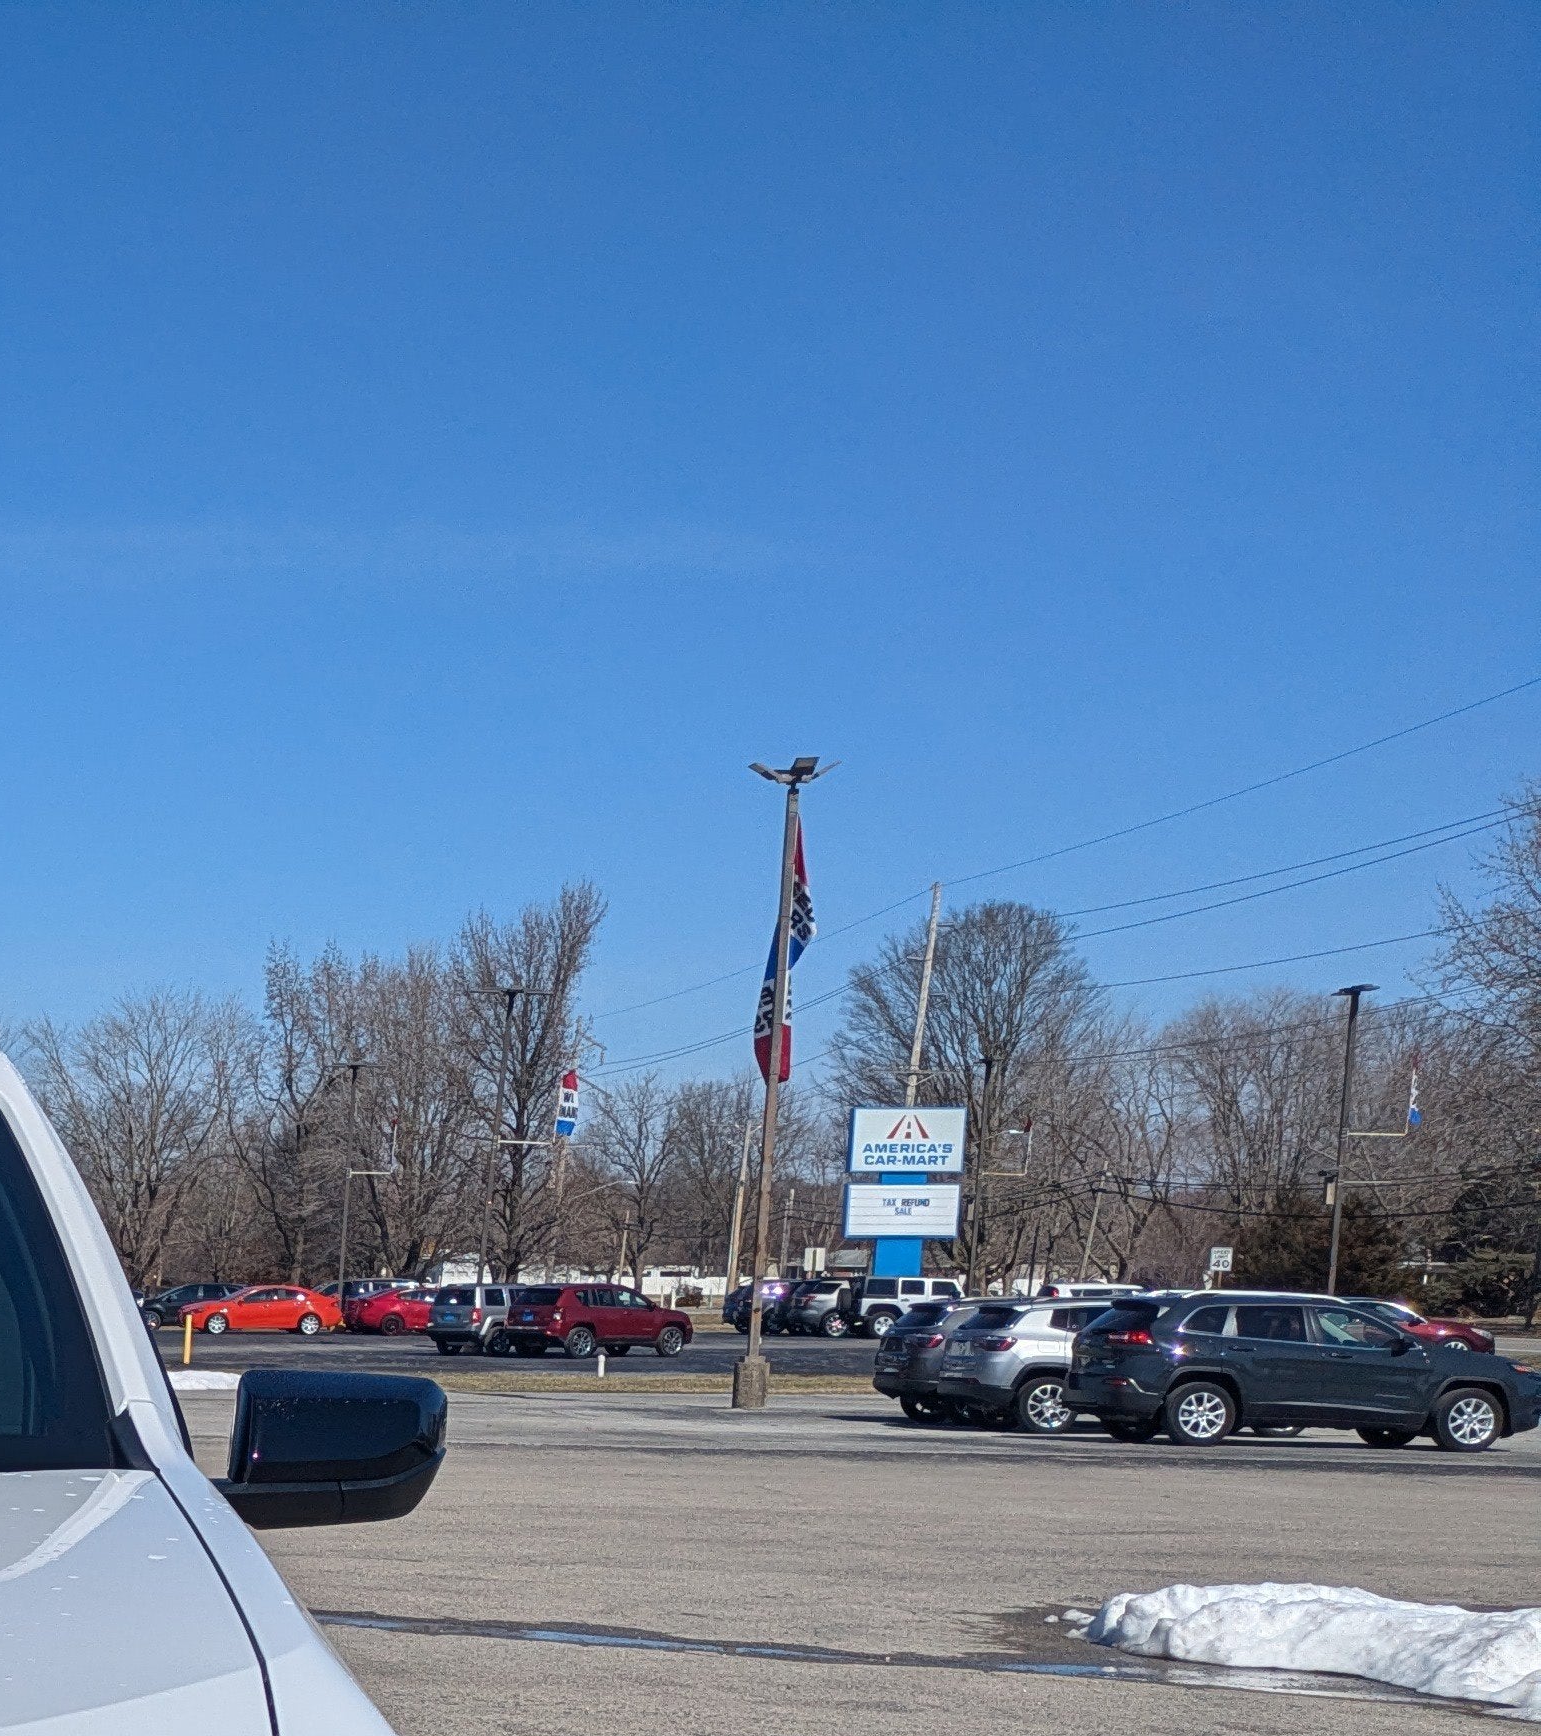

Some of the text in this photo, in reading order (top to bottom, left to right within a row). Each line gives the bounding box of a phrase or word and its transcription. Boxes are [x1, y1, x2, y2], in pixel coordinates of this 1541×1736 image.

[863, 1143, 953, 1154] AMERICA'S
[864, 1155, 949, 1166] CAR-MART
[882, 1198, 896, 1206] TAX
[894, 1207, 912, 1216] SALE
[1212, 1260, 1229, 1269] 40
